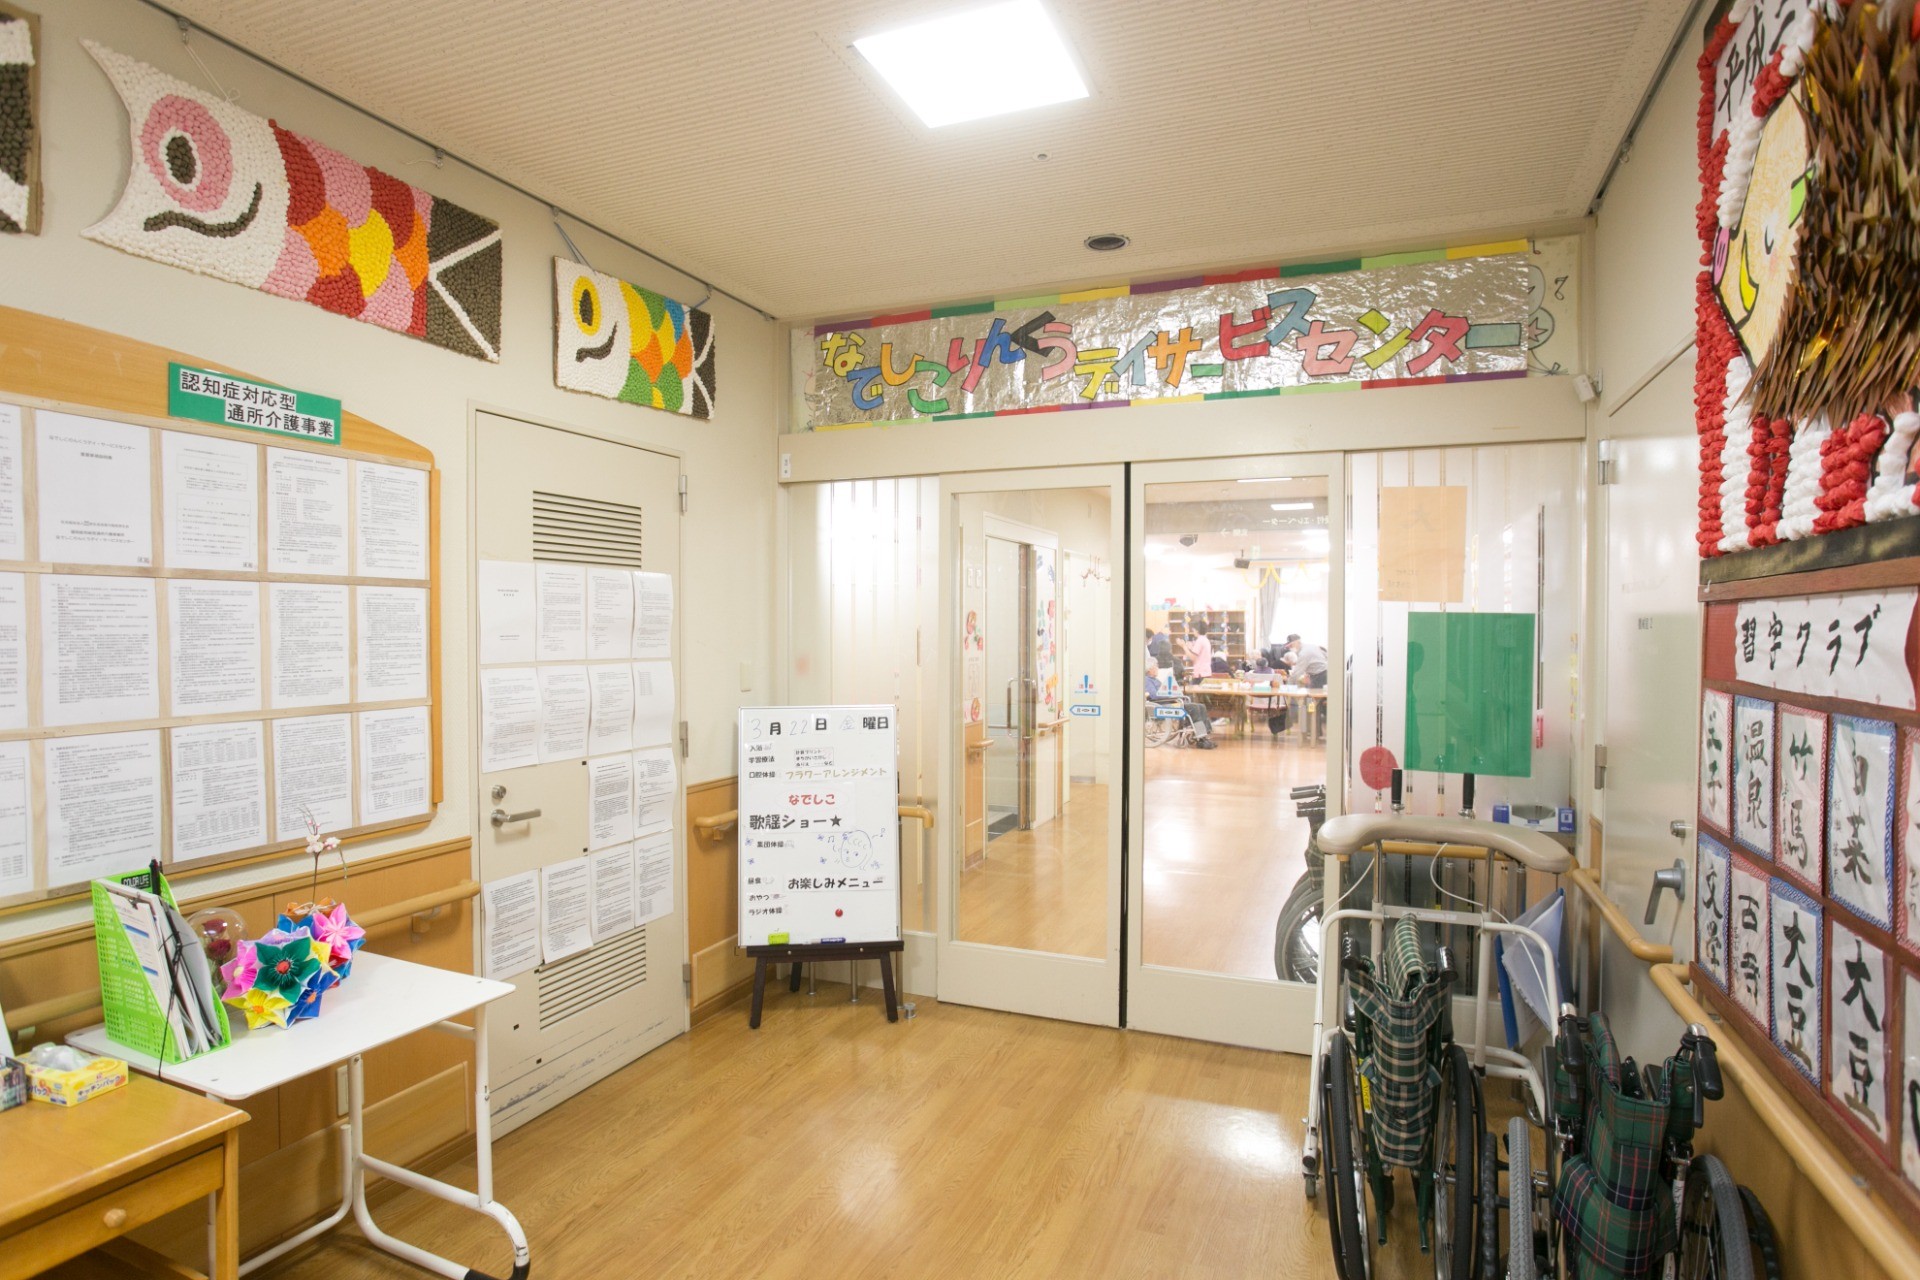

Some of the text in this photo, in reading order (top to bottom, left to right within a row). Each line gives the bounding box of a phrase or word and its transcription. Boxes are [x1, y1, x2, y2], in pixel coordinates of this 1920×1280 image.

[821, 286, 1522, 413] なでしこりんくうデイサービスセンター
[179, 369, 297, 412] 認知症対応型
[227, 402, 335, 438] 通所介護事業
[1741, 602, 1881, 677] 習字クラブ
[785, 767, 888, 780] フラワーアレンジメント
[788, 794, 836, 806] なでしこ
[1743, 718, 1768, 830] 温泉
[1789, 731, 1814, 870] 竹馬
[1840, 737, 1872, 886] 白菜
[748, 894, 770, 902] おやつ
[787, 876, 884, 890] お楽しみメニュー
[1782, 910, 1815, 1073] 大豆
[1841, 938, 1880, 1133] 大豆
